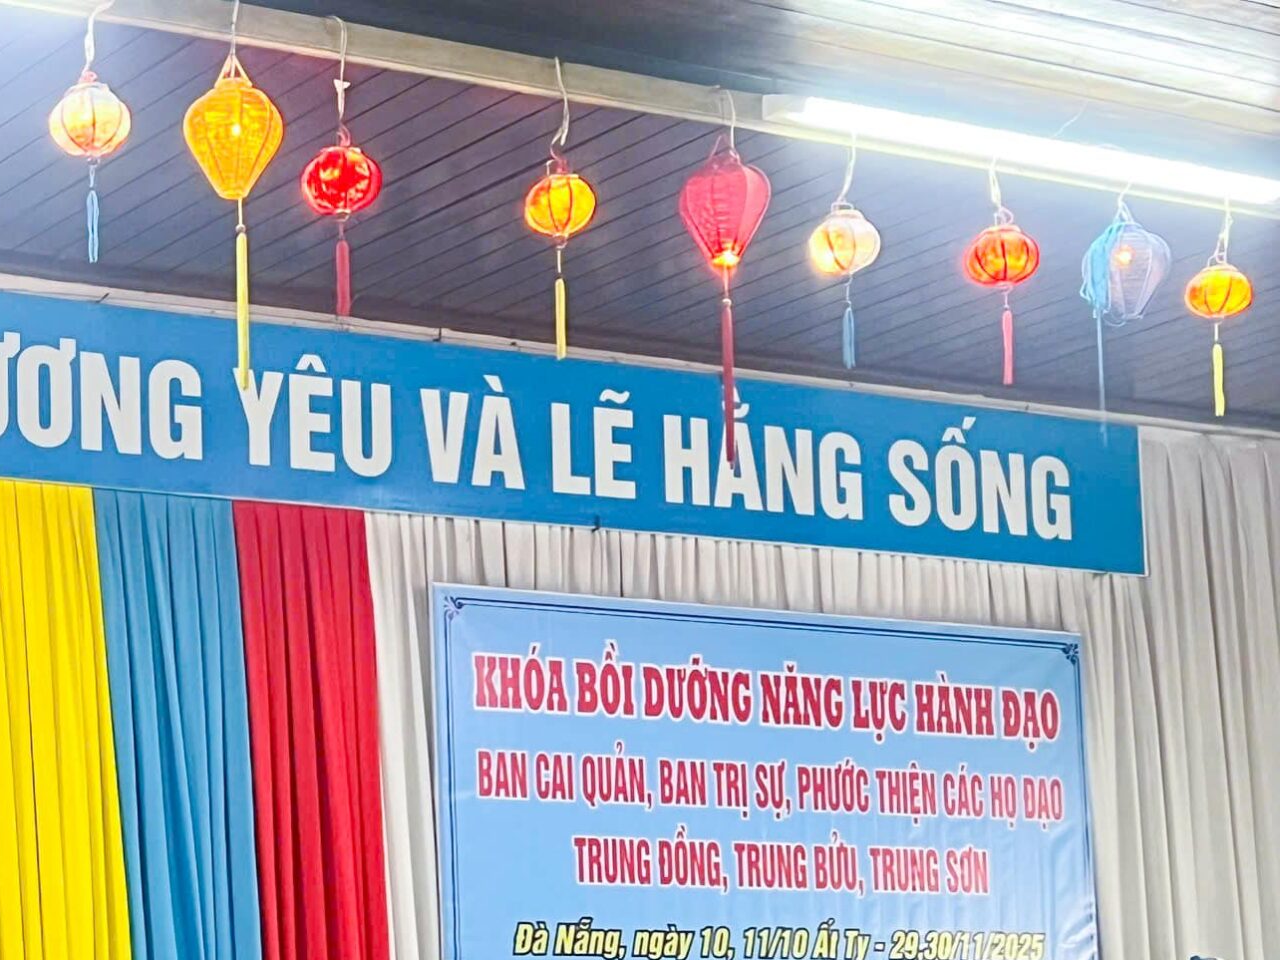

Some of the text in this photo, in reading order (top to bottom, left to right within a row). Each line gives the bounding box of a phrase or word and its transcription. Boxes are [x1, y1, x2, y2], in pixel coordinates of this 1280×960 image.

[234, 353, 393, 477] YÊU
[420, 375, 525, 490] VÀ
[550, 390, 636, 500] LẼ
[888, 416, 1073, 541] SỐNG
[474, 643, 1060, 750] KHÓA BỒI DƯỠNG NĂNG LỰC HÀNH ĐẠO
[477, 750, 528, 799] BAN
[535, 753, 575, 800] CAI
[582, 742, 652, 809] QUẢN,
[659, 759, 707, 806] BAN
[713, 762, 749, 818] TRỊ
[755, 761, 792, 820] SỰ,
[797, 759, 869, 812] PHƯỚC
[876, 763, 936, 824] THIỆN
[943, 766, 984, 818] CÁC
[990, 775, 1017, 828] HỌ
[574, 825, 989, 896] TRUNG ĐỒNG, TRUNG BỬU, TRUNG SƠN
[513, 922, 549, 955] Đà
[700, 926, 735, 960] 10,
[743, 926, 809, 960] 11/10
